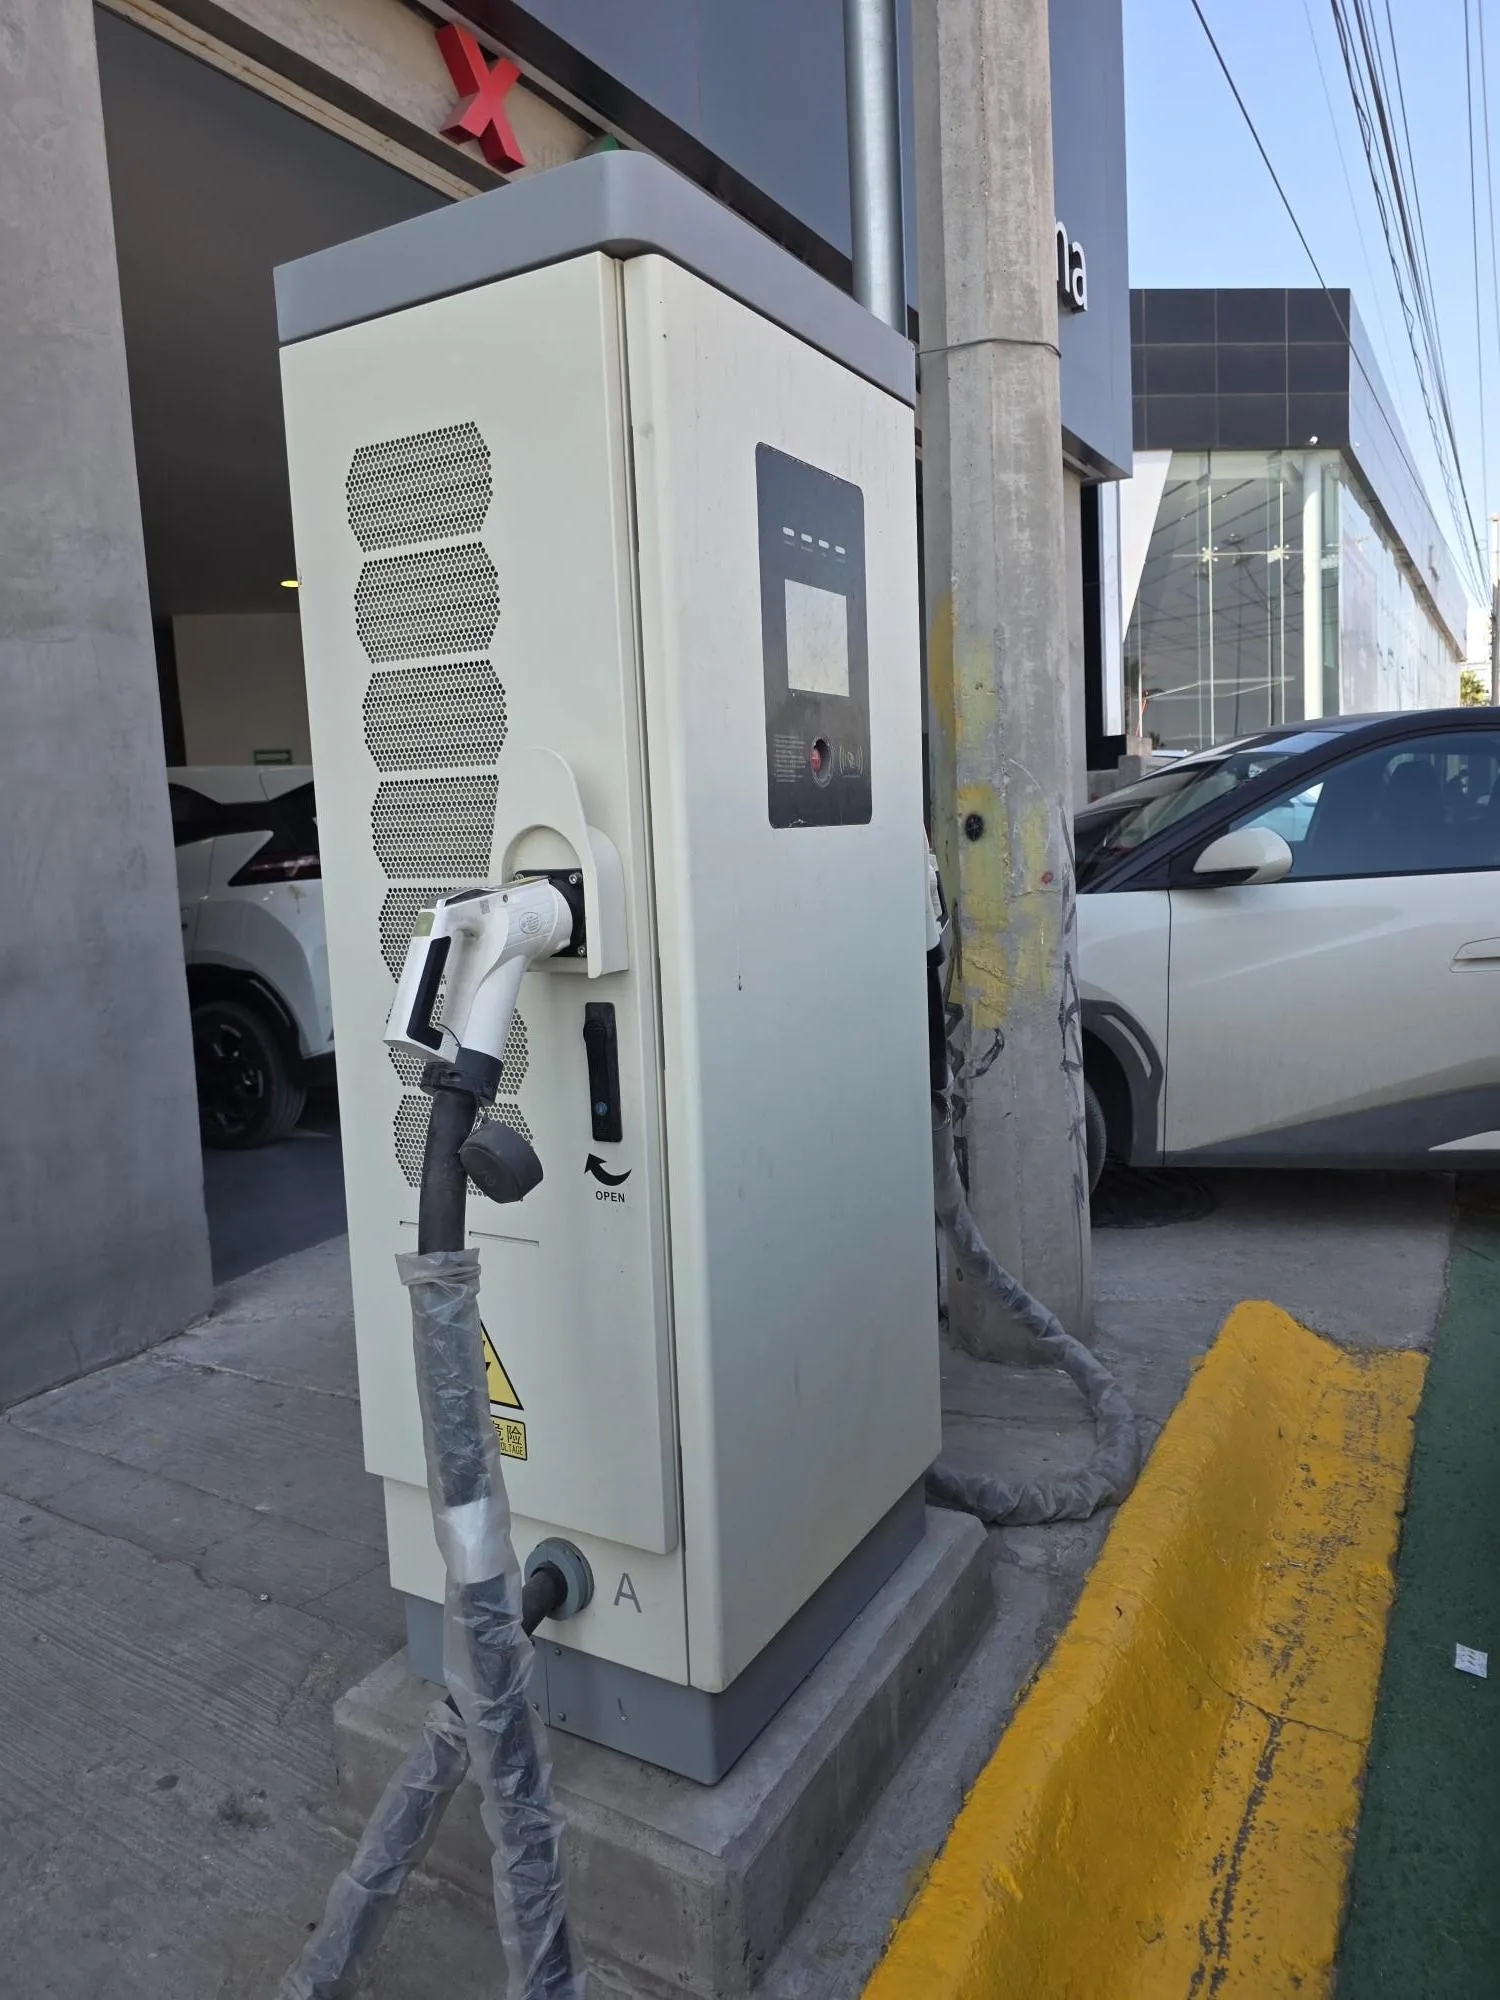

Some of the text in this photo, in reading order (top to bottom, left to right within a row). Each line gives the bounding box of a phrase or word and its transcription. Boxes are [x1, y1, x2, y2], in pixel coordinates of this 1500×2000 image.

[595, 1190, 625, 1203] OPEN
[500, 1441, 524, 1456] OLTAGE
[613, 1572, 642, 1613] A
